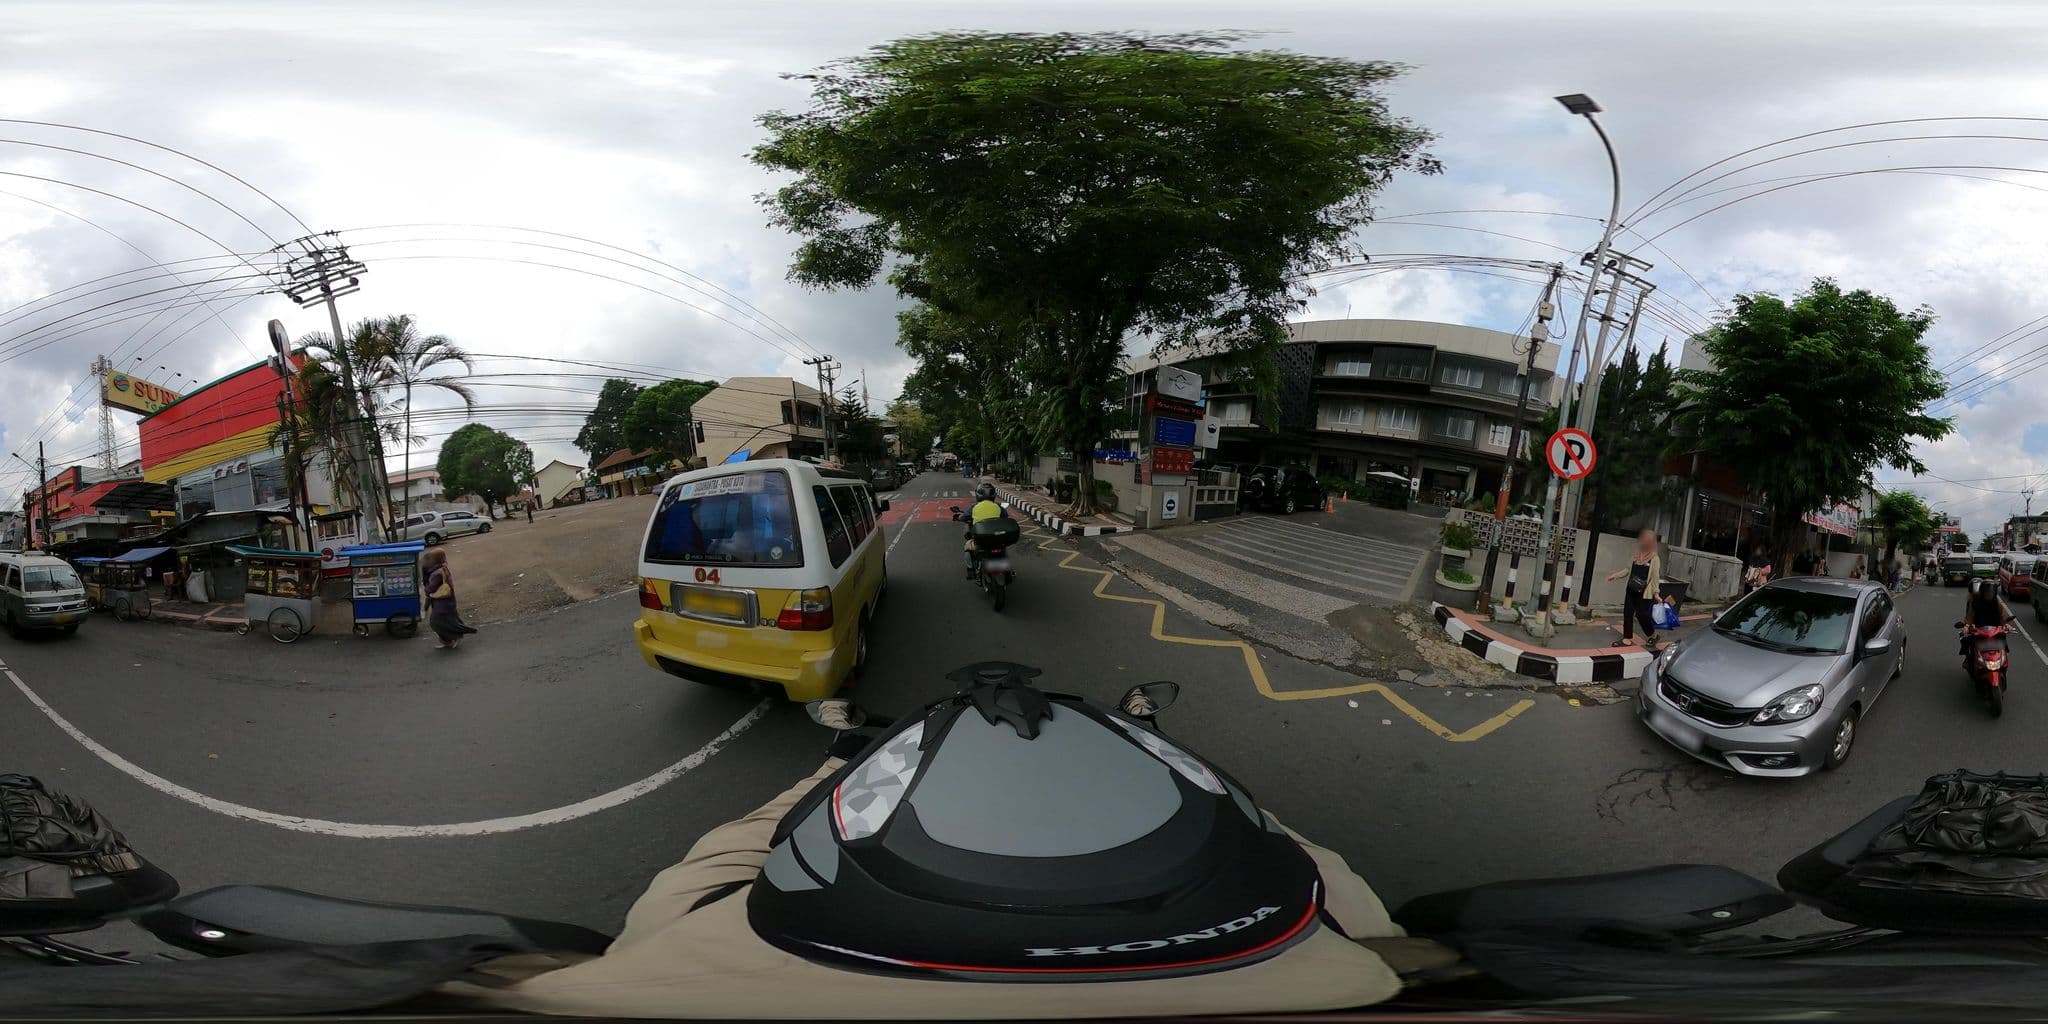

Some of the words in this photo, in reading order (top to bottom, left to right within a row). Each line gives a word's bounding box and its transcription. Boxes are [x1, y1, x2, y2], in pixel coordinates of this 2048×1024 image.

[1562, 438, 1585, 470] P
[694, 567, 720, 585] 04
[1023, 905, 1281, 957] HONDA
